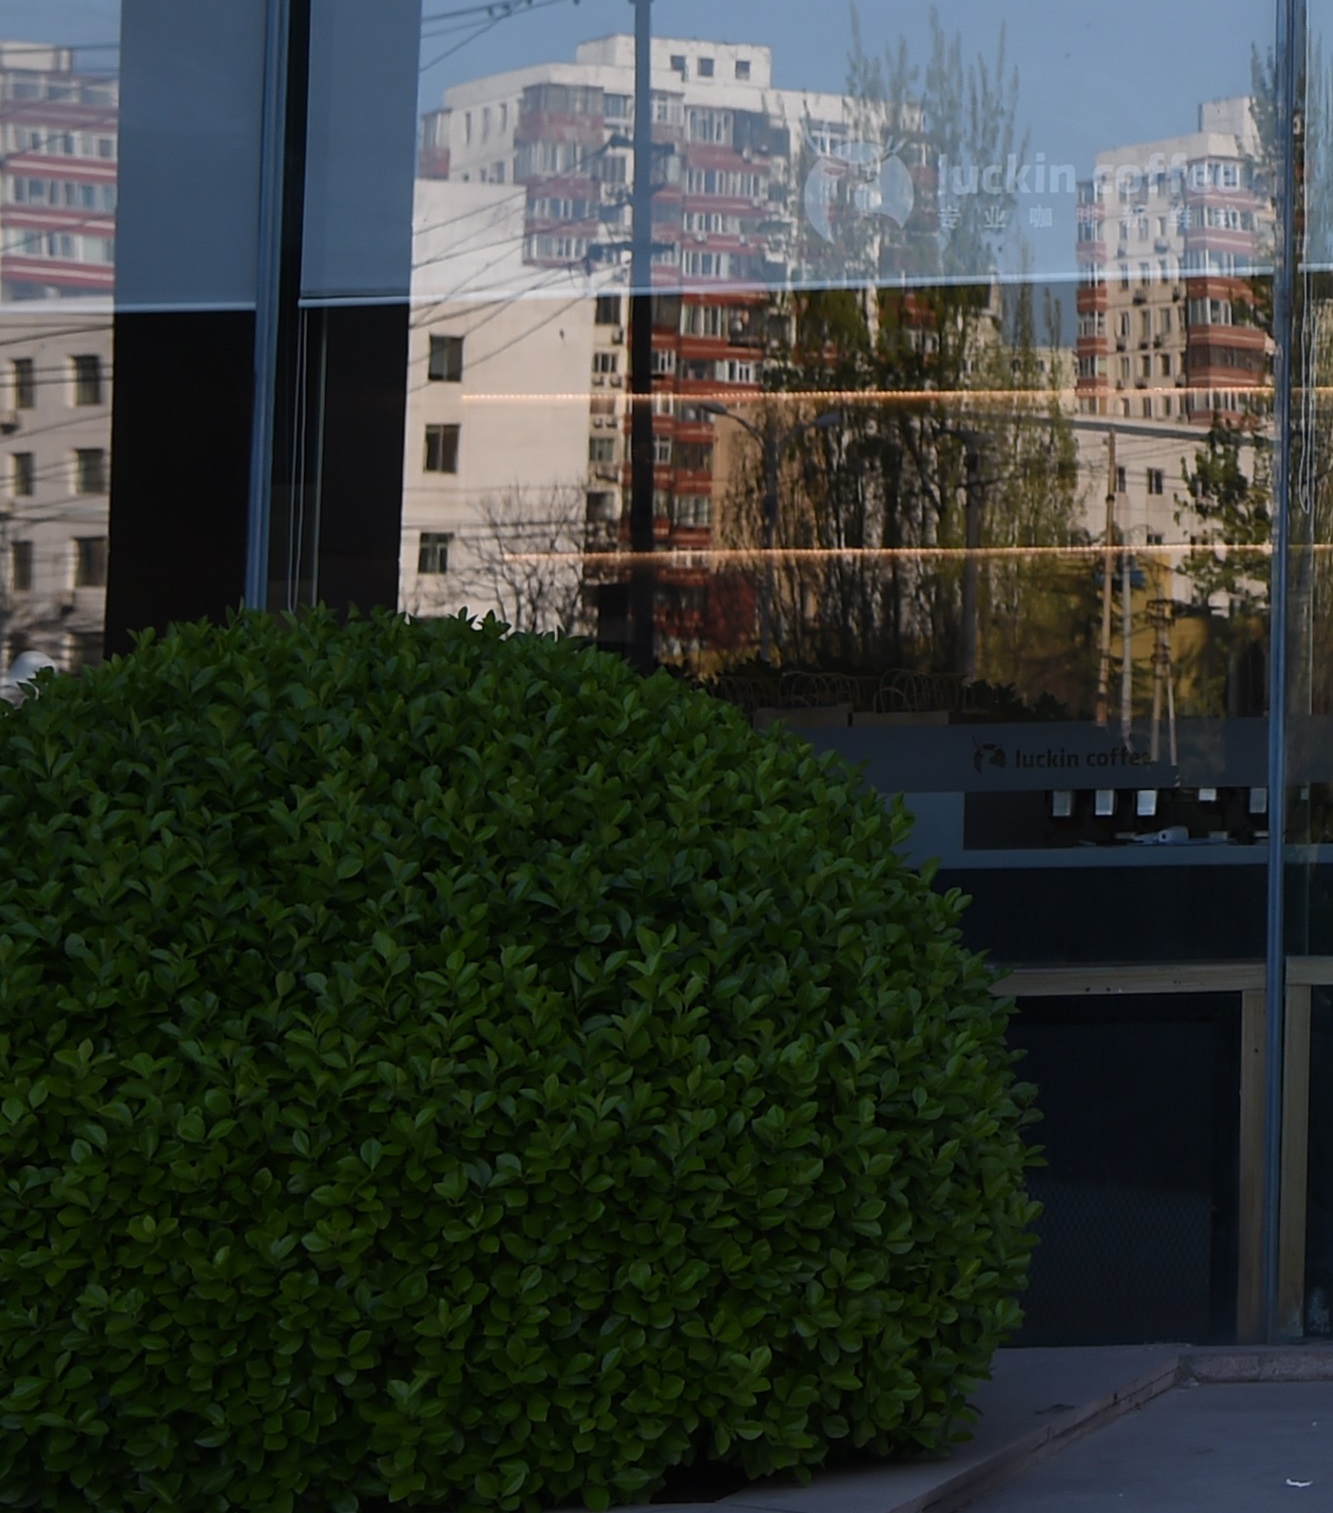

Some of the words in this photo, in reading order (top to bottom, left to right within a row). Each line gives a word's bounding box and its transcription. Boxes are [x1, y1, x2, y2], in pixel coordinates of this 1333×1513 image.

[938, 152, 1077, 196] luckin
[1093, 151, 1241, 194] coffee
[1015, 747, 1079, 769] luckin
